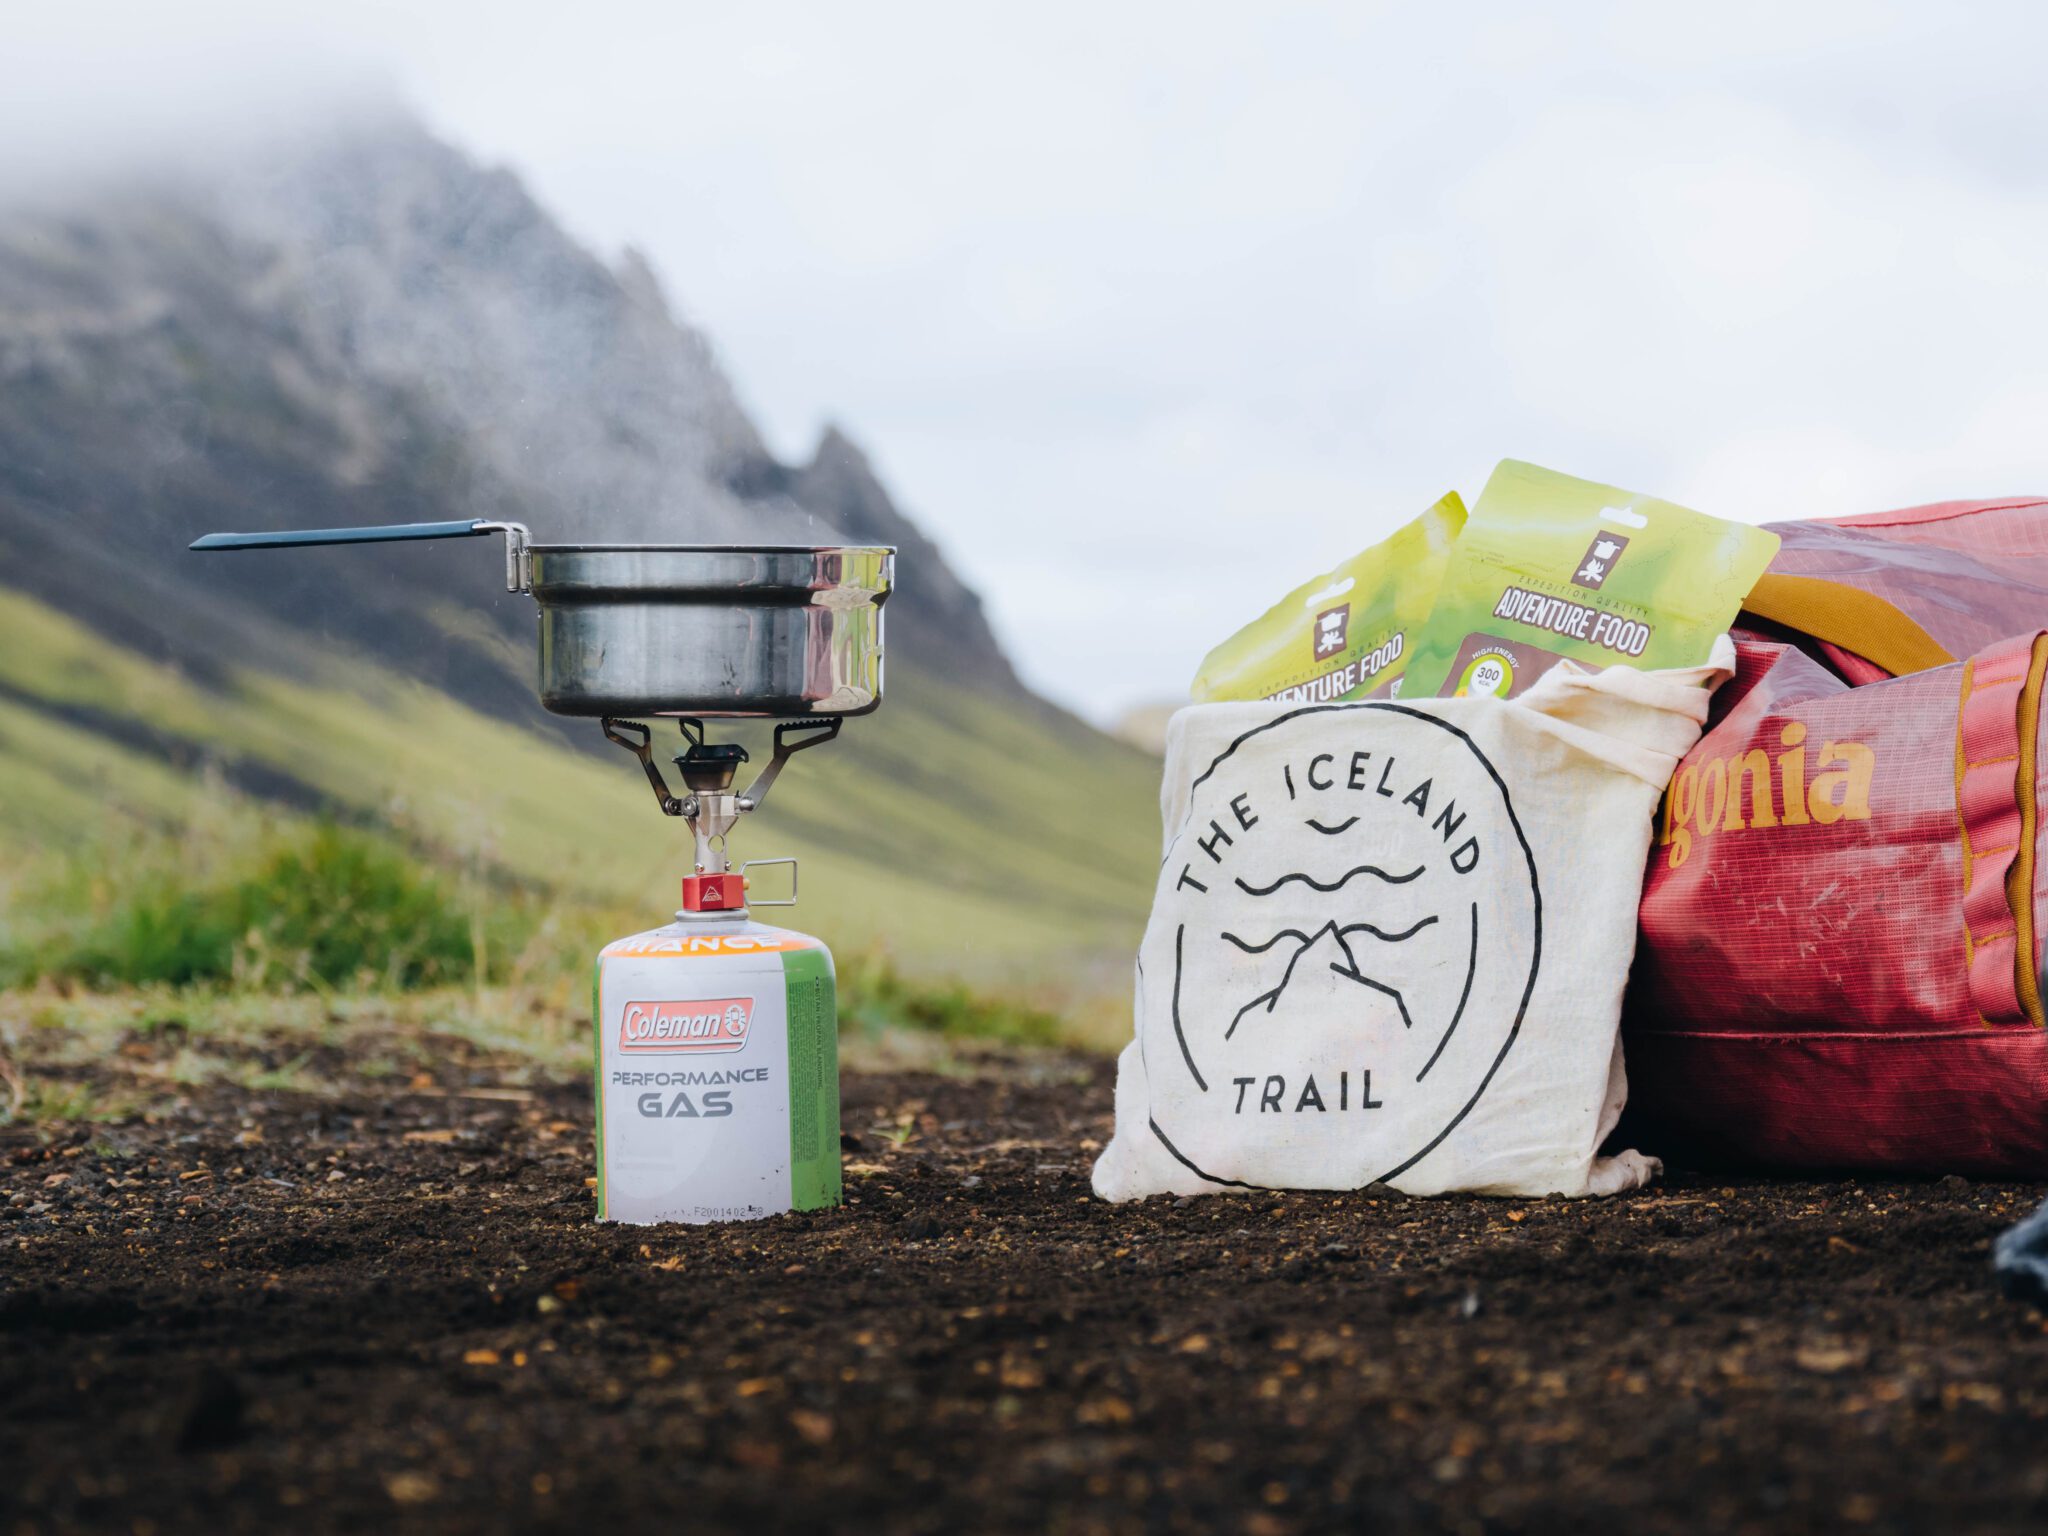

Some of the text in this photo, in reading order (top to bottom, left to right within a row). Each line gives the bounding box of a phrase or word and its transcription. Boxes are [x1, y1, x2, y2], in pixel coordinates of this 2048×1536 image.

[1494, 587, 1650, 656] ADVENTURE FOOD
[1596, 596, 1649, 618] QUALITY
[1360, 633, 1403, 683] FOOD
[1472, 646, 1520, 669] HIGH ENERGY
[1477, 667, 1500, 681] 300
[1661, 722, 1876, 869] gonia
[1177, 751, 1481, 894] THE ICELAND
[626, 1006, 722, 1041] Coleman
[612, 1067, 769, 1086] PERFORMANCE
[1232, 1069, 1383, 1115] TRAIL
[637, 1091, 733, 1118] GAS
